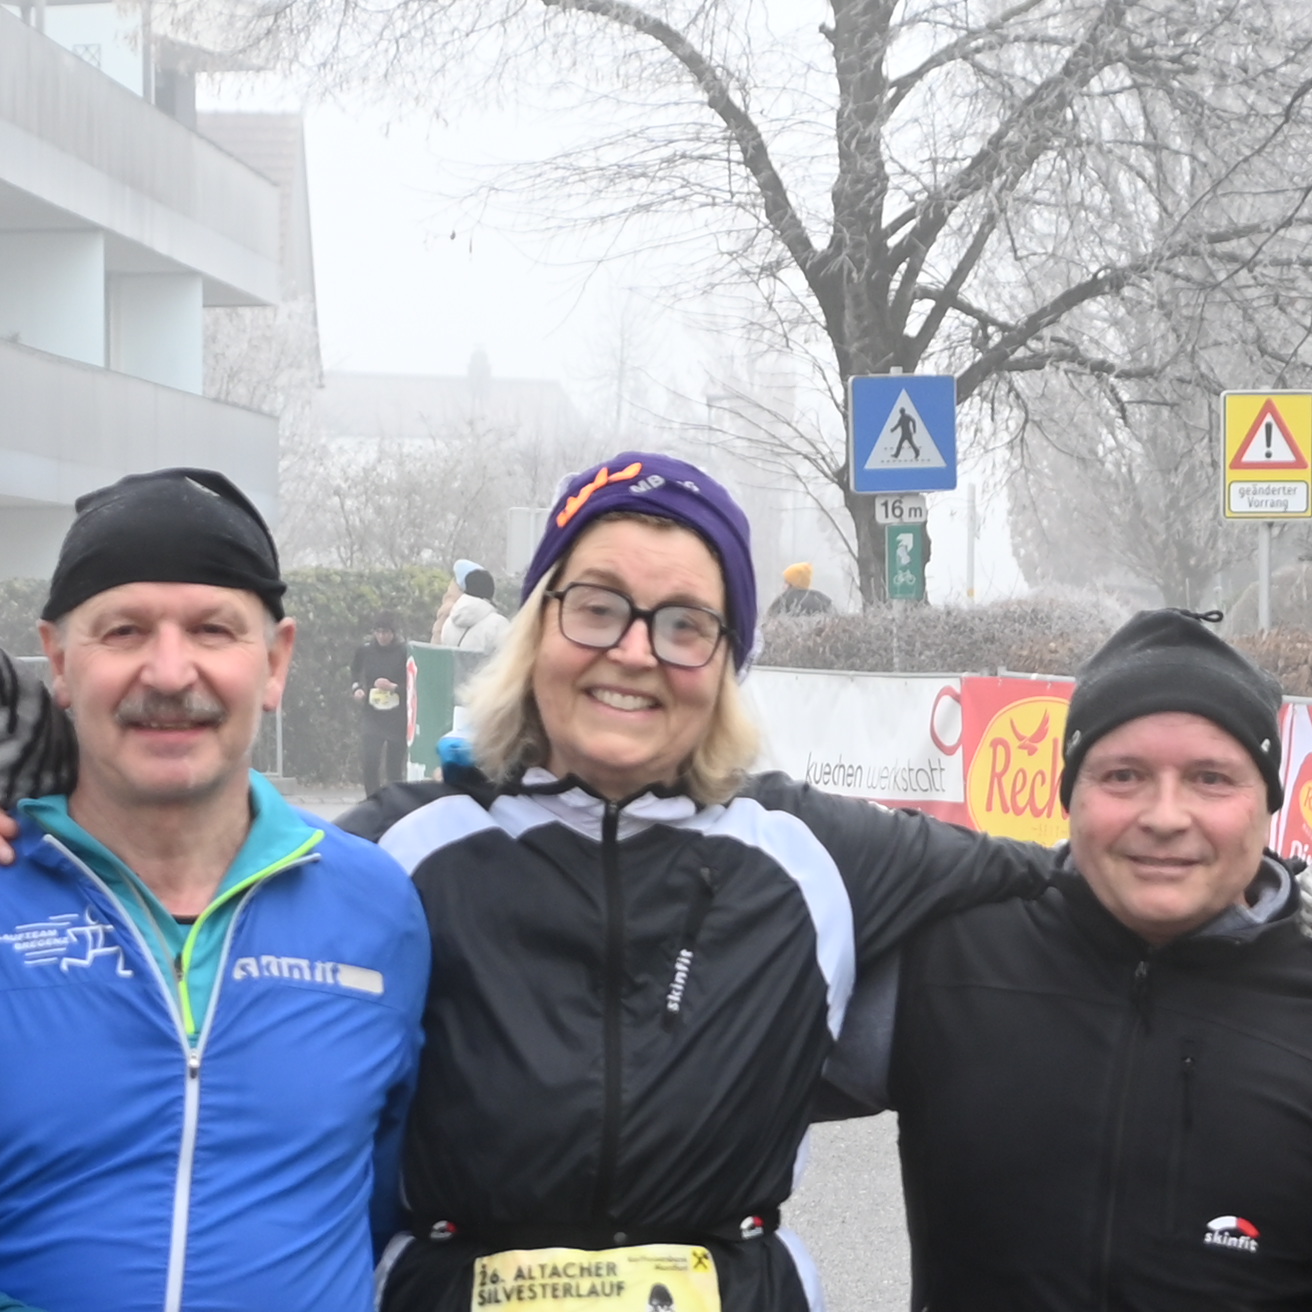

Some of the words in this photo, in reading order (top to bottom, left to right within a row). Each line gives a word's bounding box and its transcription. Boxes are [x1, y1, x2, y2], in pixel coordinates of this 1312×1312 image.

[1238, 483, 1298, 498] geänderter
[881, 499, 904, 519] 16
[908, 506, 923, 518] m
[1248, 497, 1289, 513] Vorrang
[805, 752, 863, 790] kuechen
[866, 758, 945, 793] werkstatt
[667, 948, 694, 1013] skinfit
[1204, 1229, 1259, 1253] skinfit
[479, 1264, 504, 1285] 26.
[513, 1262, 617, 1282] ALTACHER
[477, 1281, 626, 1307] SILVESTERLAUF
